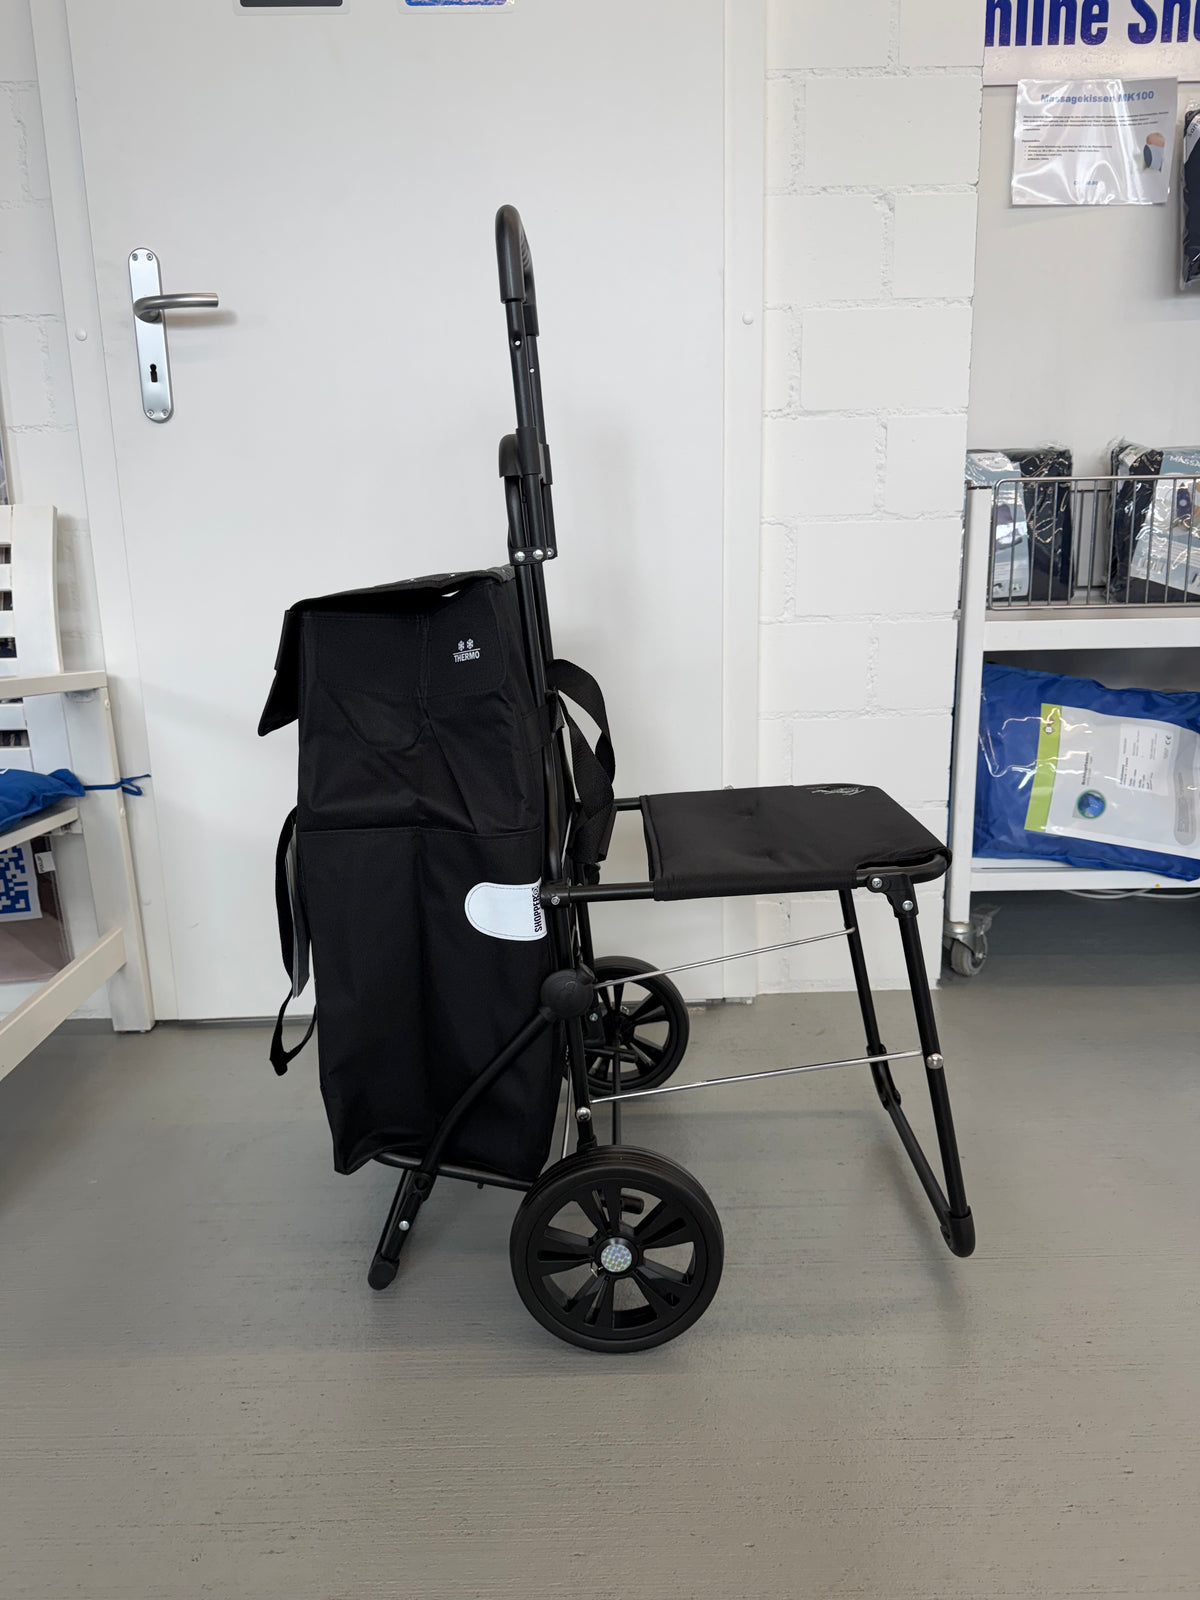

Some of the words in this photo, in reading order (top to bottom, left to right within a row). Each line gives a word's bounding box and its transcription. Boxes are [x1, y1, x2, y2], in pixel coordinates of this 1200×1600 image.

[1128, 0, 1200, 45] Sh
[1118, 91, 1154, 103] MK100
[454, 650, 480, 663] THERMO
[533, 895, 542, 933] SHOPPER
